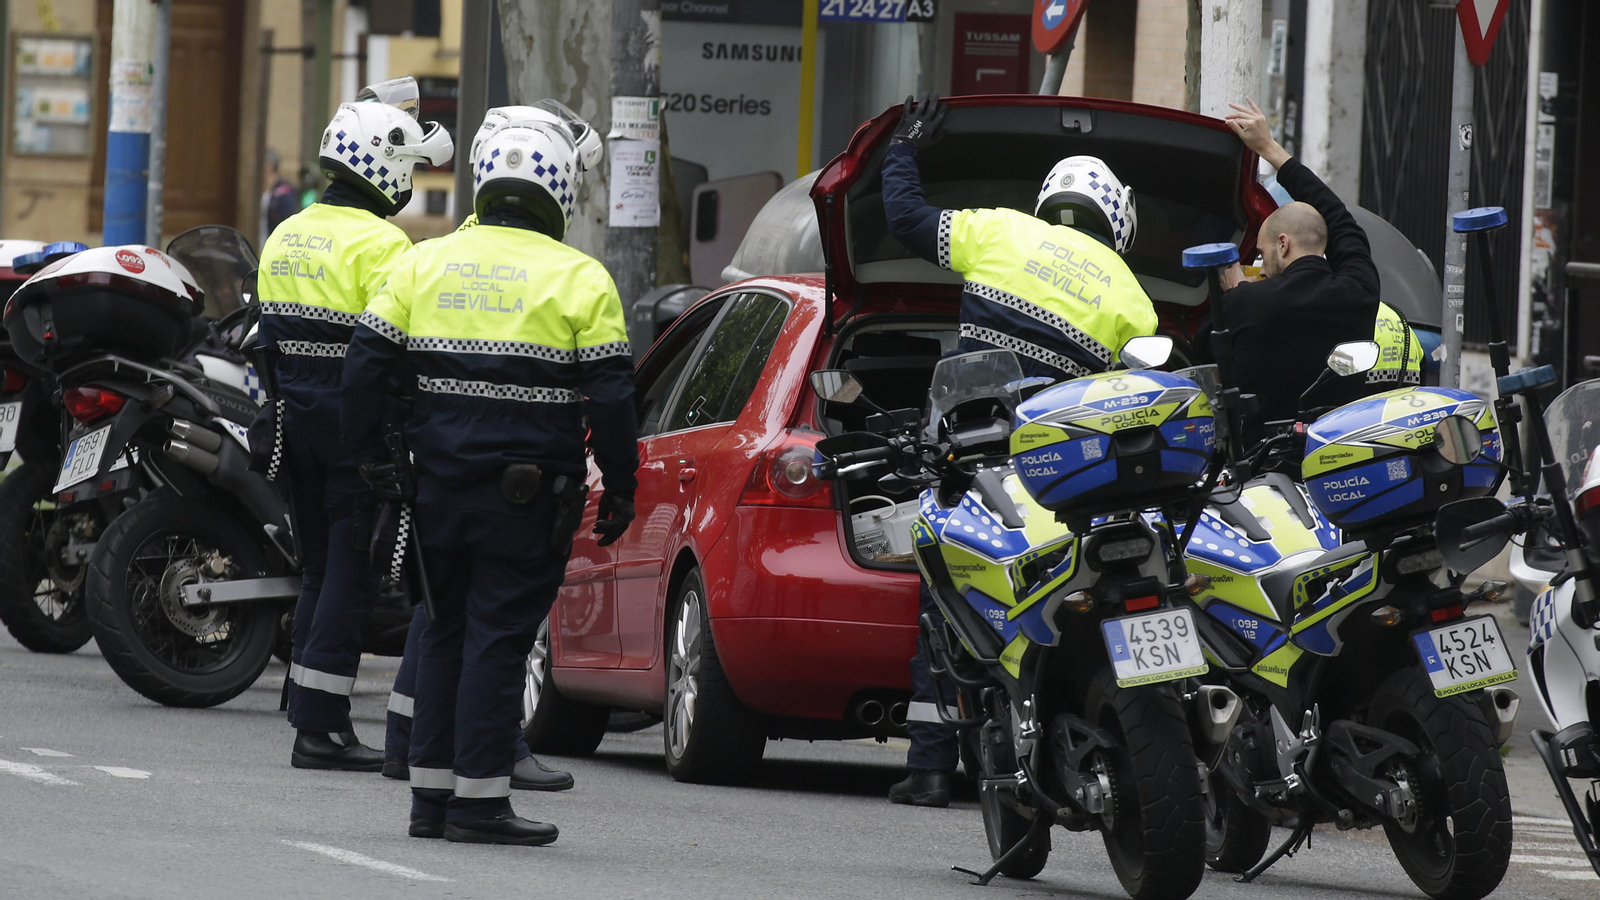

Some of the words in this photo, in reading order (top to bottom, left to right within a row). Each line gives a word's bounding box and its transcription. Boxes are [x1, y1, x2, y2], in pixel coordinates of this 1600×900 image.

[681, 1, 729, 15] Channel
[821, 0, 845, 16] 21
[849, 0, 877, 18] 24
[879, 0, 906, 19] 27
[907, 0, 934, 18] A3
[966, 31, 1020, 42] TUSSAM
[700, 93, 772, 116] Series
[279, 234, 333, 253] POLICIA
[285, 250, 312, 261] LOCAL
[271, 261, 326, 282] SEVILLA
[443, 263, 528, 282] POLICIA
[1038, 241, 1112, 288] POLICIA
[1052, 259, 1089, 285] LOCAL
[461, 281, 504, 293] LOCAL
[1023, 259, 1102, 309] SEVILLA
[437, 292, 524, 314] SEVILLA
[1104, 395, 1149, 409] M-239
[1101, 407, 1161, 427] POLICÍA
[1115, 419, 1150, 430] LOCAL
[1407, 410, 1449, 426] M-238
[76, 429, 107, 457] 6691
[70, 453, 96, 478] FLD
[1021, 451, 1063, 465] POLICÍA
[1025, 466, 1058, 477] LOCAL
[1323, 475, 1370, 490] POLICÍA
[1327, 490, 1366, 502] LOCAL
[989, 609, 1005, 619] 092
[993, 620, 1004, 630] 112
[1129, 615, 1189, 645] 4539
[1237, 619, 1258, 629] 092
[1243, 630, 1257, 640] 112
[1439, 623, 1495, 655] 4524
[1132, 642, 1182, 670] KSN
[1444, 649, 1492, 680] KSN
[1152, 672, 1174, 682] LOCAL
[1174, 668, 1202, 677] SEVILLA
[1467, 681, 1487, 689] LOCAL
[1487, 674, 1513, 684] SEVILLA
